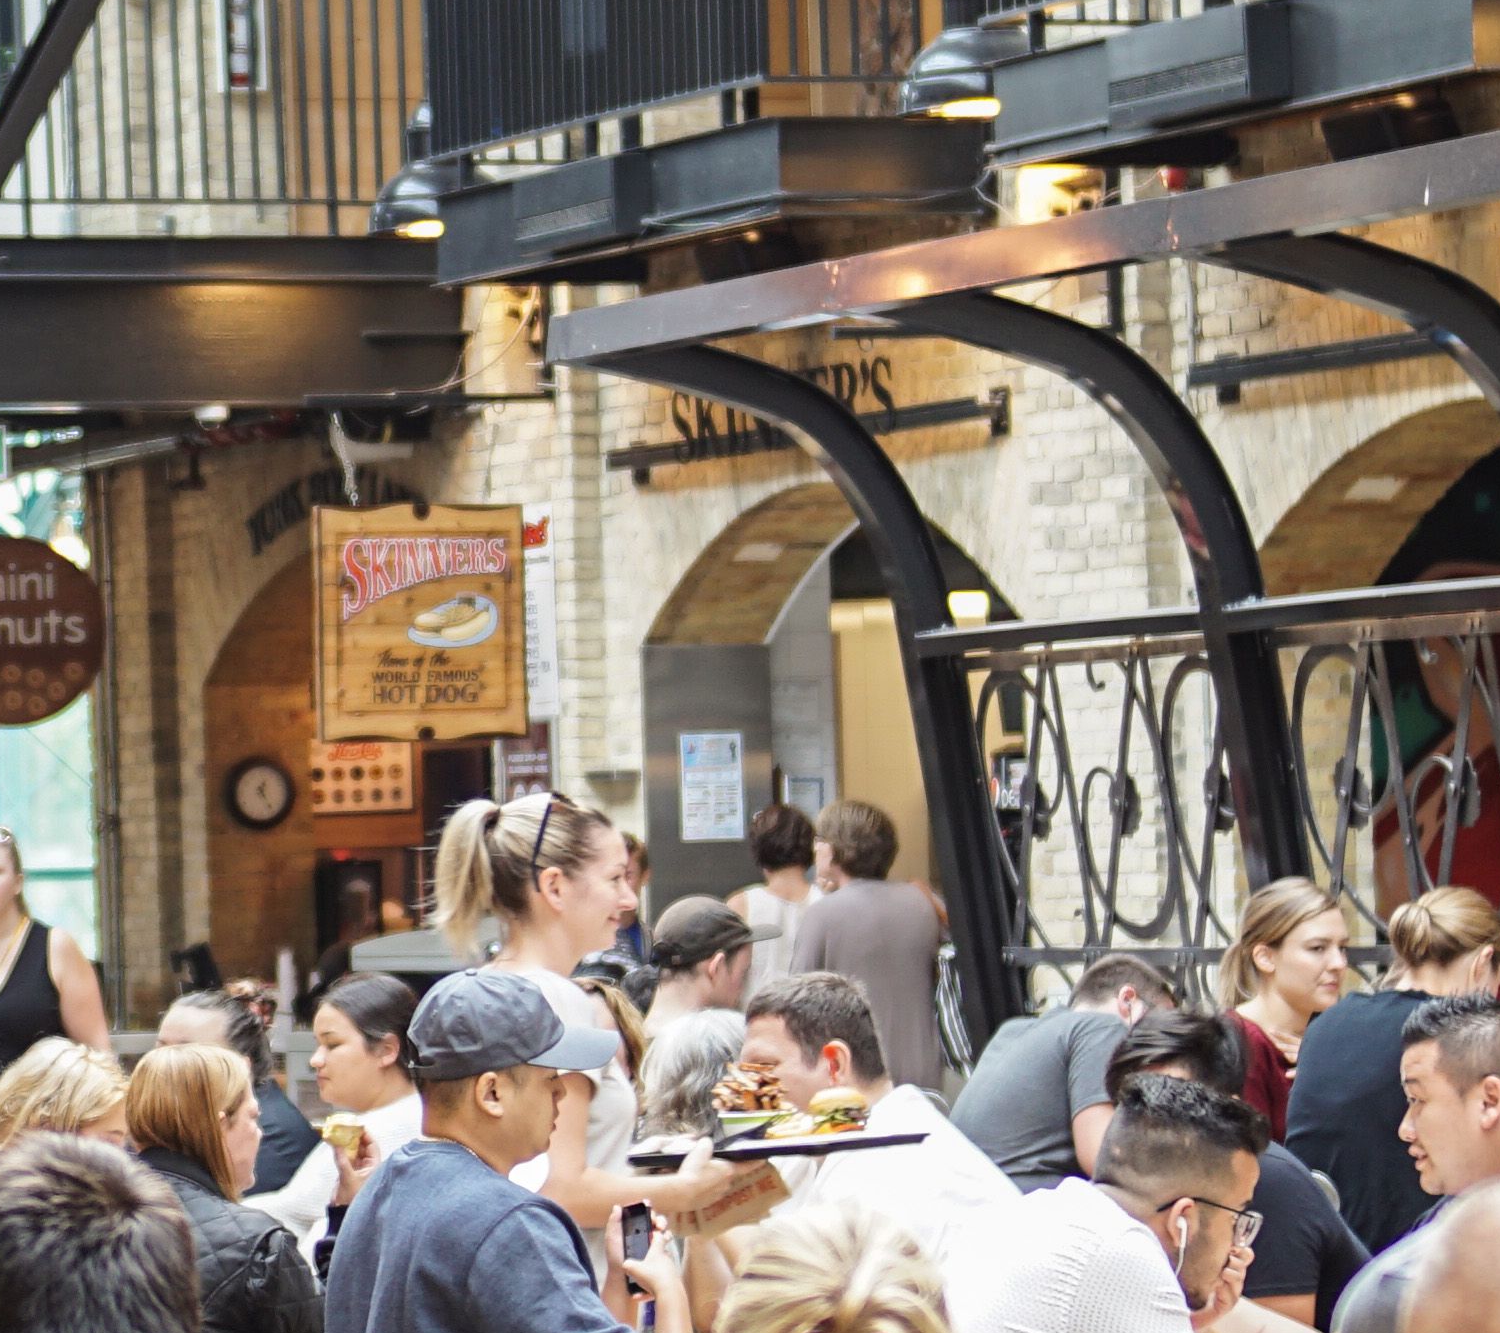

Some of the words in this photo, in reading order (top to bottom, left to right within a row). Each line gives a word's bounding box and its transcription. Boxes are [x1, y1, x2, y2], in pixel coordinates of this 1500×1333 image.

[342, 536, 508, 622] SKINNERS
[371, 669, 421, 684] WORLD
[426, 669, 480, 683] FAMOUS
[372, 683, 421, 704] HOT
[424, 682, 480, 704] DOG
